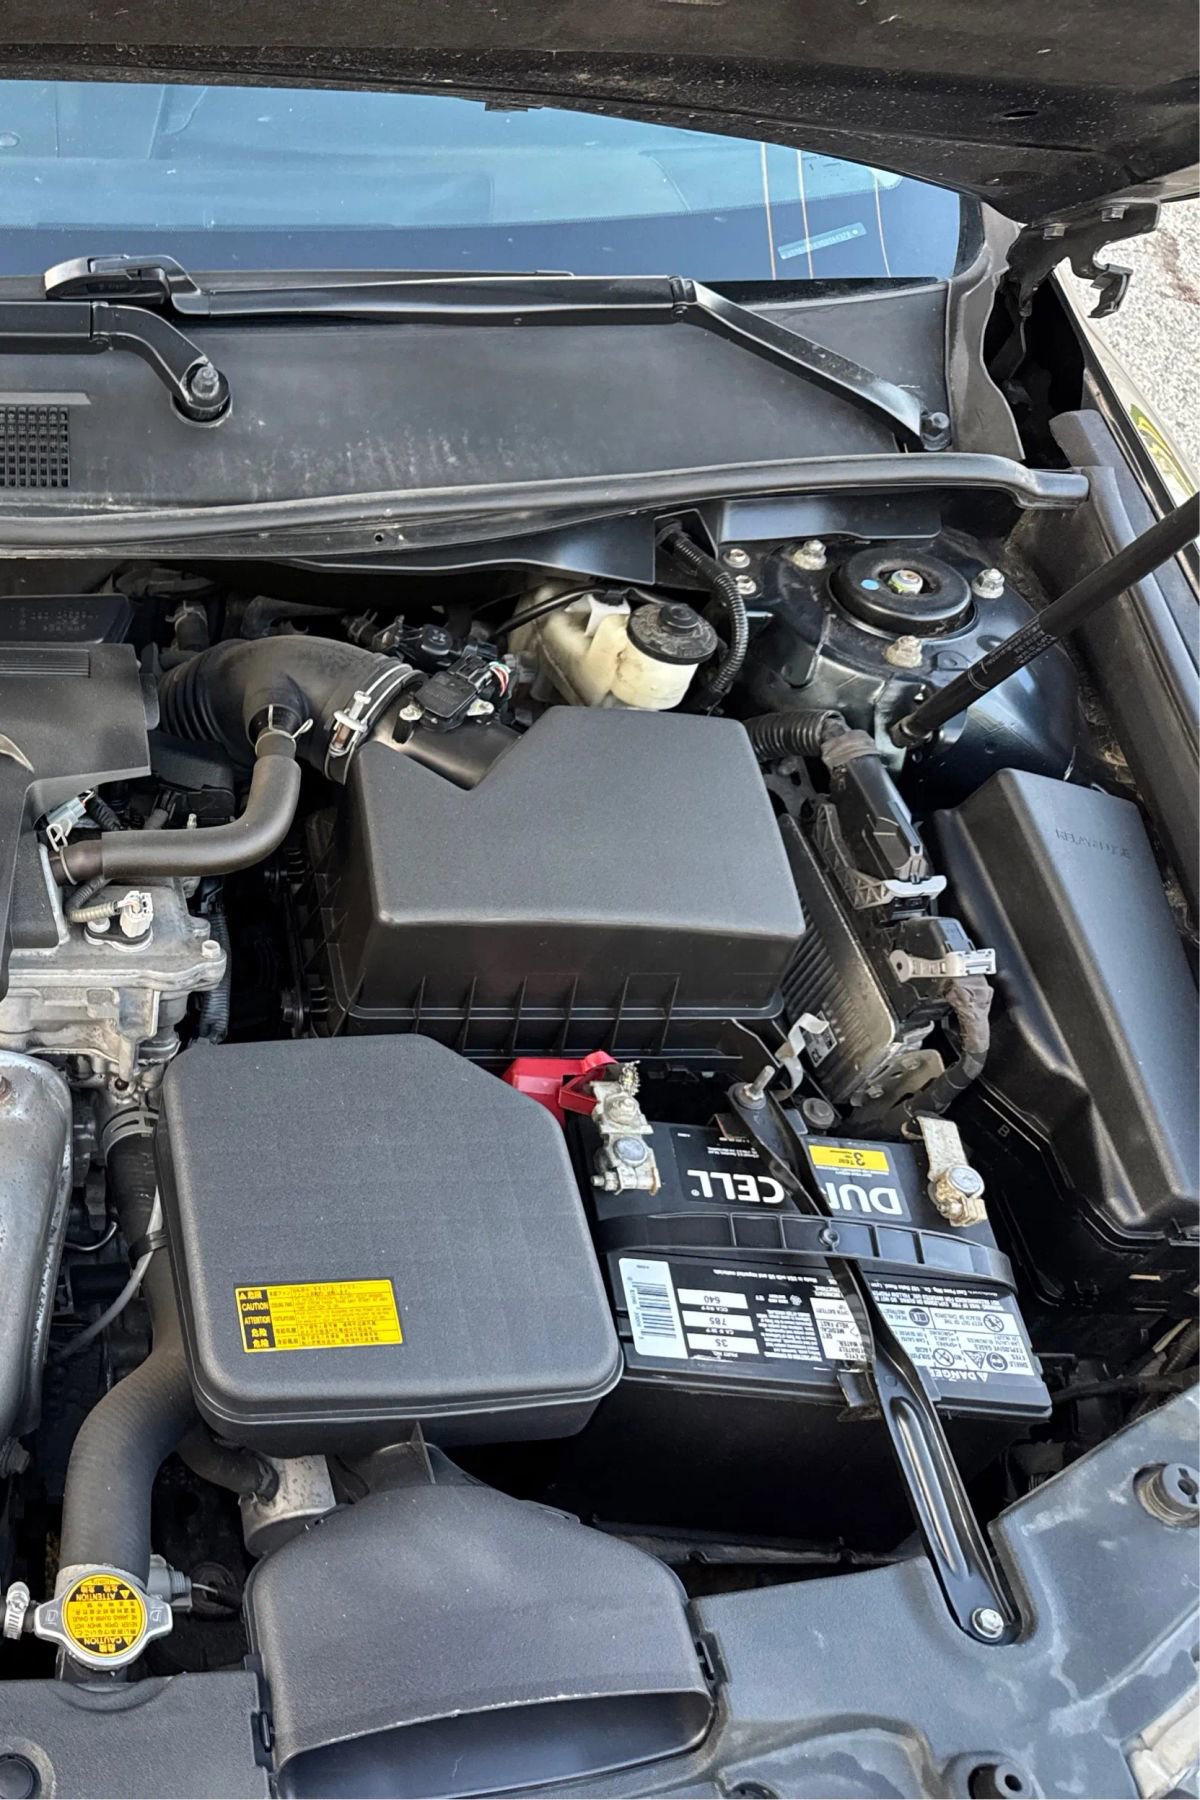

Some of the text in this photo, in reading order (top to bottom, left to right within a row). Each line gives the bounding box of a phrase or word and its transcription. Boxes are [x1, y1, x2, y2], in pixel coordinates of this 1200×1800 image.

[854, 1152, 866, 1167] 3
[703, 1295, 720, 1304] 640
[241, 1302, 269, 1311] CAUTION
[244, 1316, 271, 1325] ATTENTION
[709, 1316, 727, 1326] 785
[715, 1338, 728, 1347] 35
[75, 1592, 116, 1601] ATTENTION
[83, 1636, 123, 1645] CAUTION
